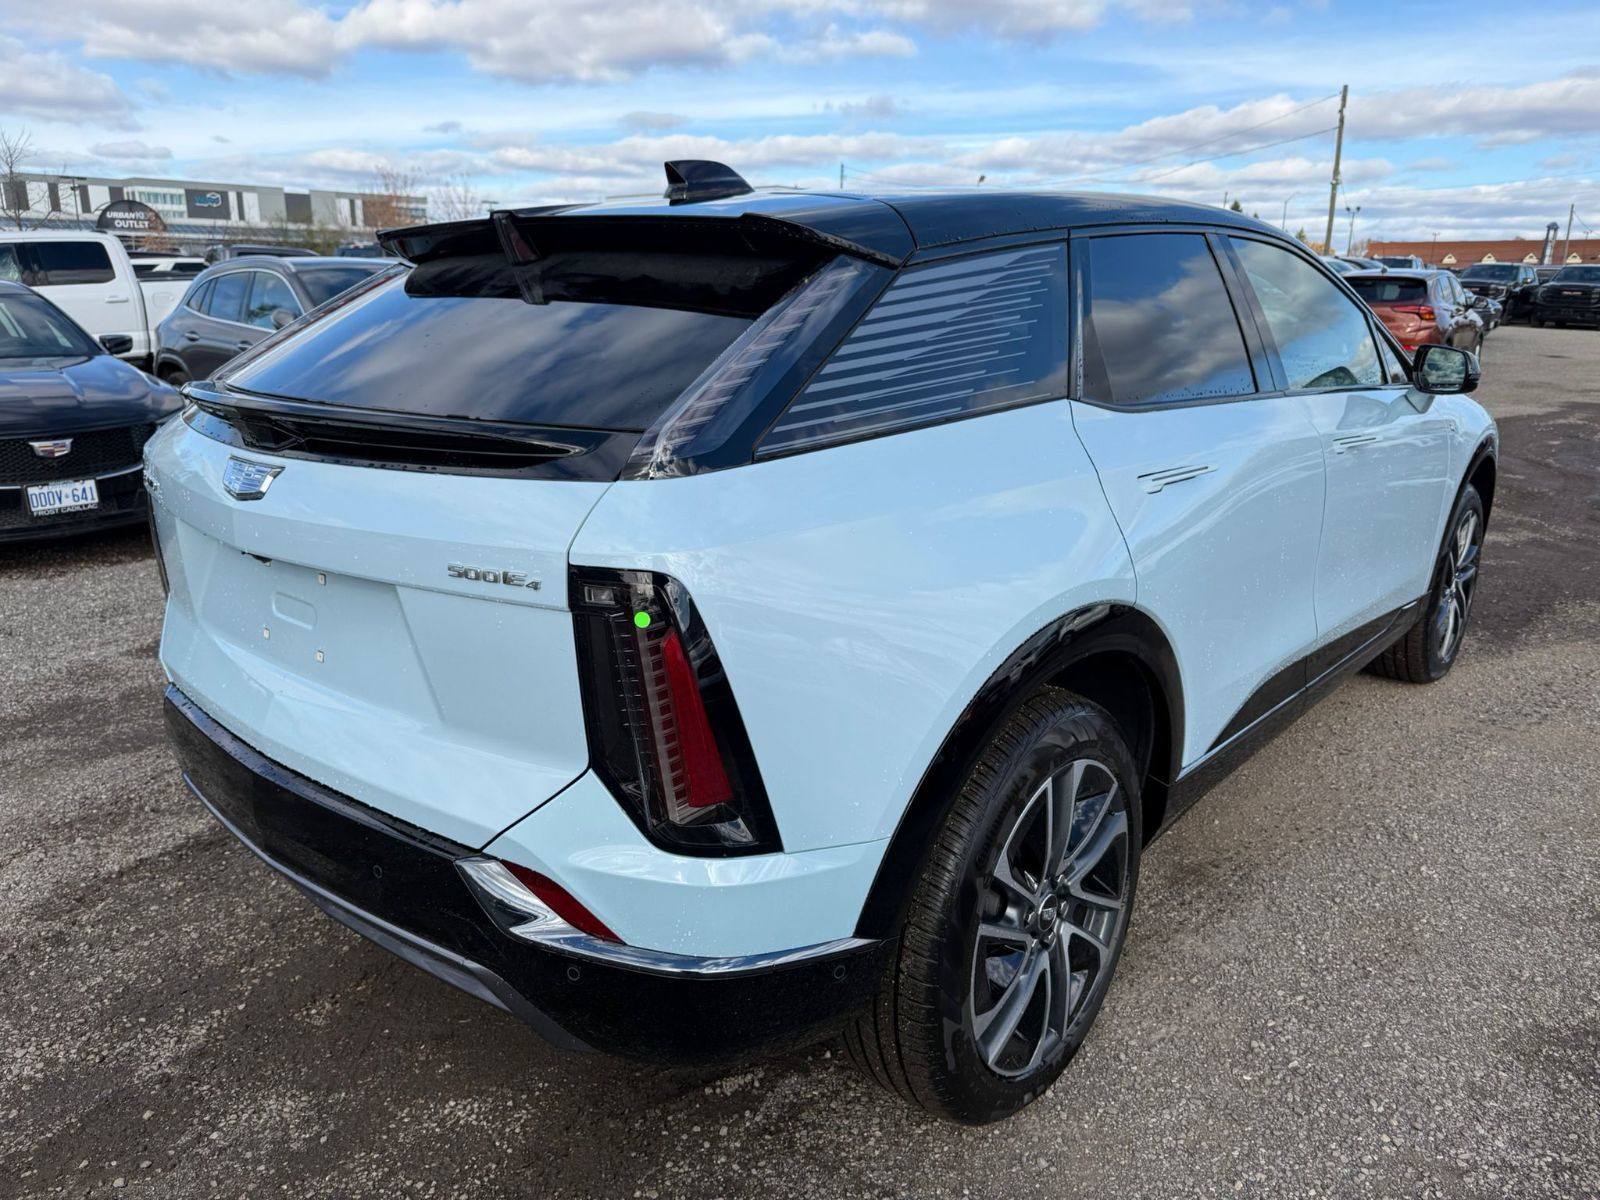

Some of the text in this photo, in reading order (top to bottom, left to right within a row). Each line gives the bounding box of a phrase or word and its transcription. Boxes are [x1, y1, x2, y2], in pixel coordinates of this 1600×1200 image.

[114, 219, 150, 229] OUTLET
[71, 486, 95, 503] 641
[33, 503, 98, 517] FROST CADILLAC
